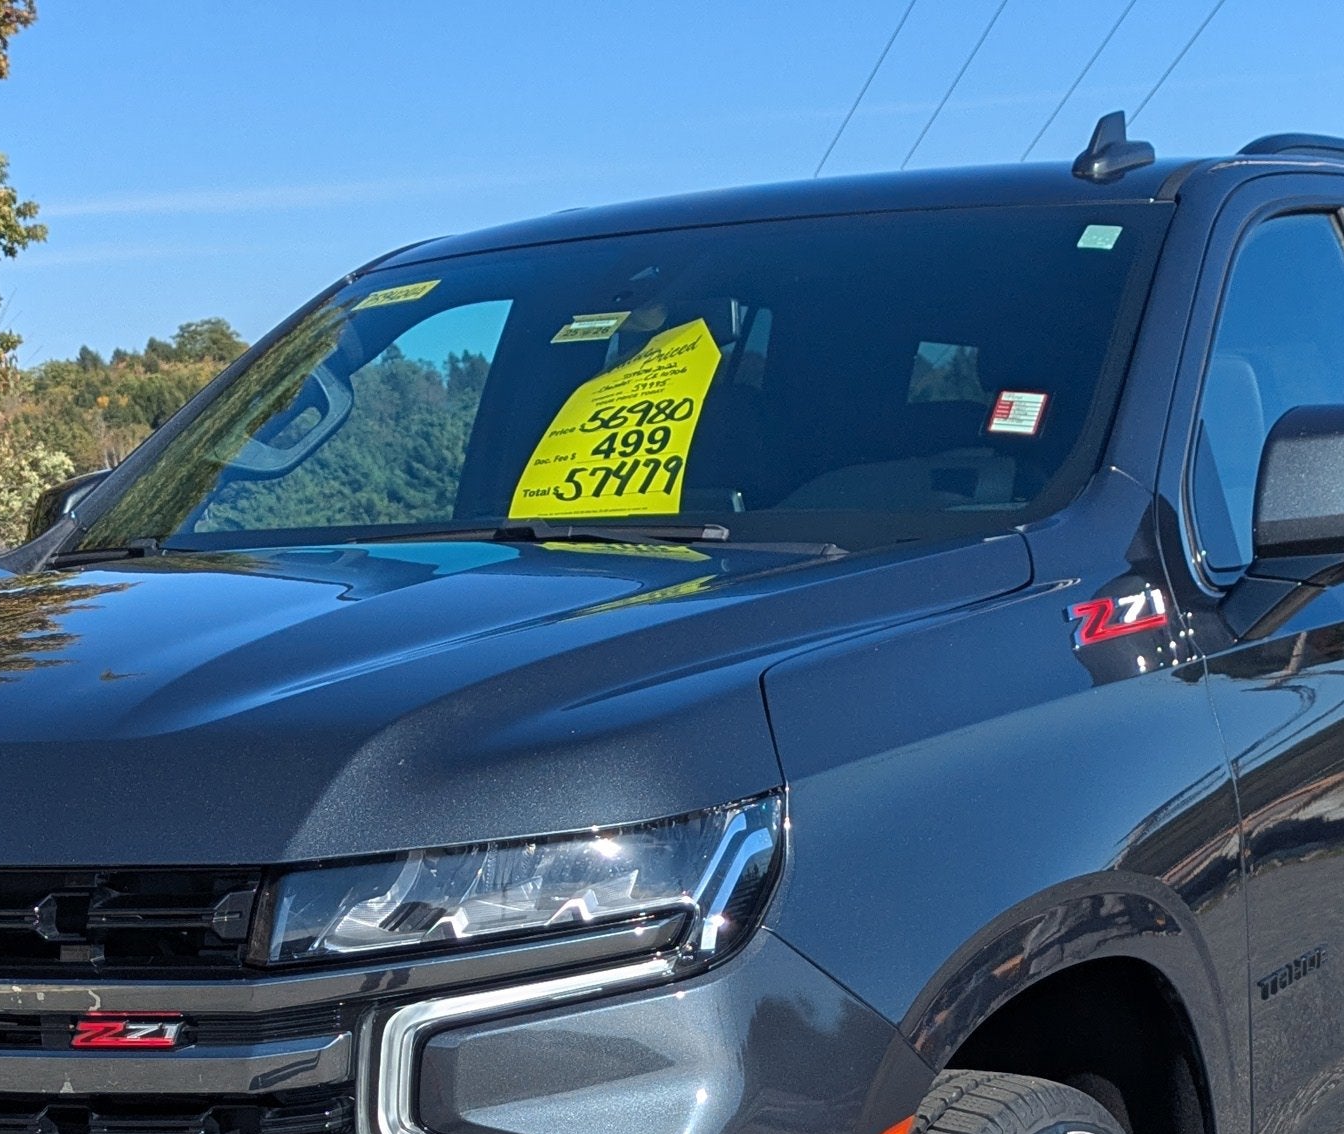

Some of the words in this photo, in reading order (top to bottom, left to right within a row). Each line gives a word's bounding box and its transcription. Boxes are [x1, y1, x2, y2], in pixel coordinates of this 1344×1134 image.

[549, 426, 576, 438] Price
[553, 455, 570, 463] Fee
[591, 426, 672, 459] 499
[522, 488, 551, 498] Total
[1067, 588, 1167, 645] Z71
[71, 1020, 178, 1050] Z71
